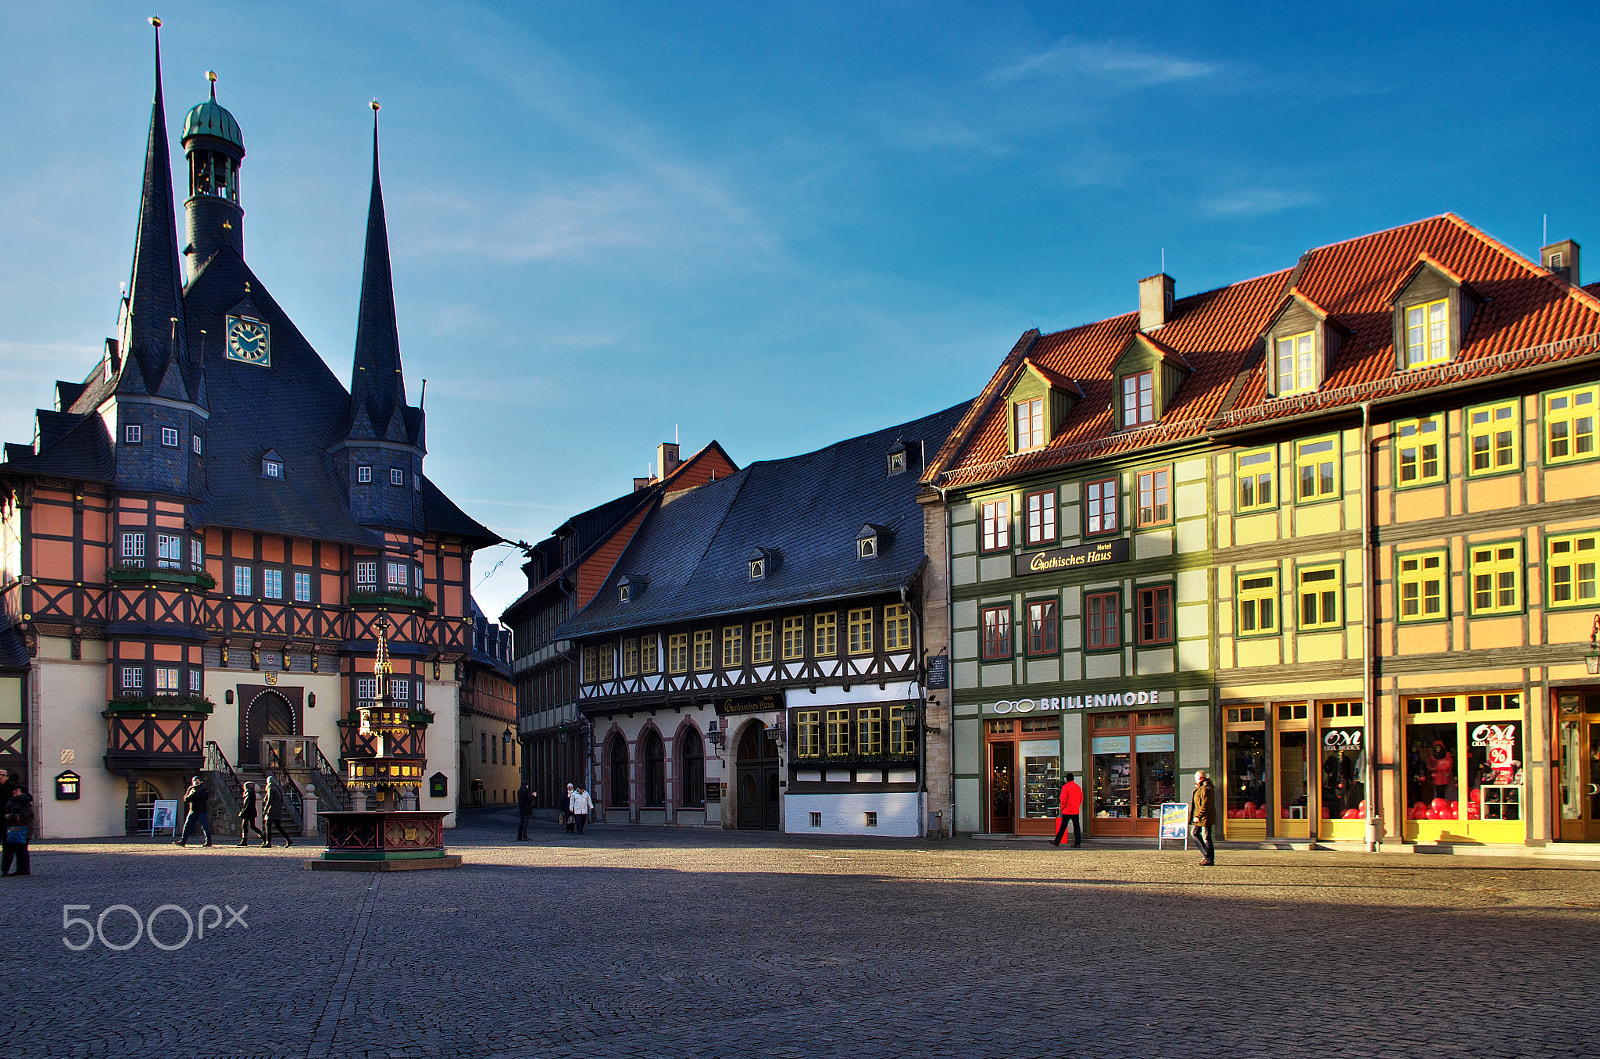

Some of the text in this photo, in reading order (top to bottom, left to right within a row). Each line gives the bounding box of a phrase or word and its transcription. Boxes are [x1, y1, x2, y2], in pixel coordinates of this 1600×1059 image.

[1097, 543, 1112, 551] Hotel
[1030, 551, 1112, 571] Gothisches Haus
[759, 701, 775, 710] Haus
[1040, 690, 1159, 711] BRILLENMODE
[1324, 730, 1361, 746] OM
[1472, 724, 1516, 741] OM
[1491, 749, 1506, 763] %
